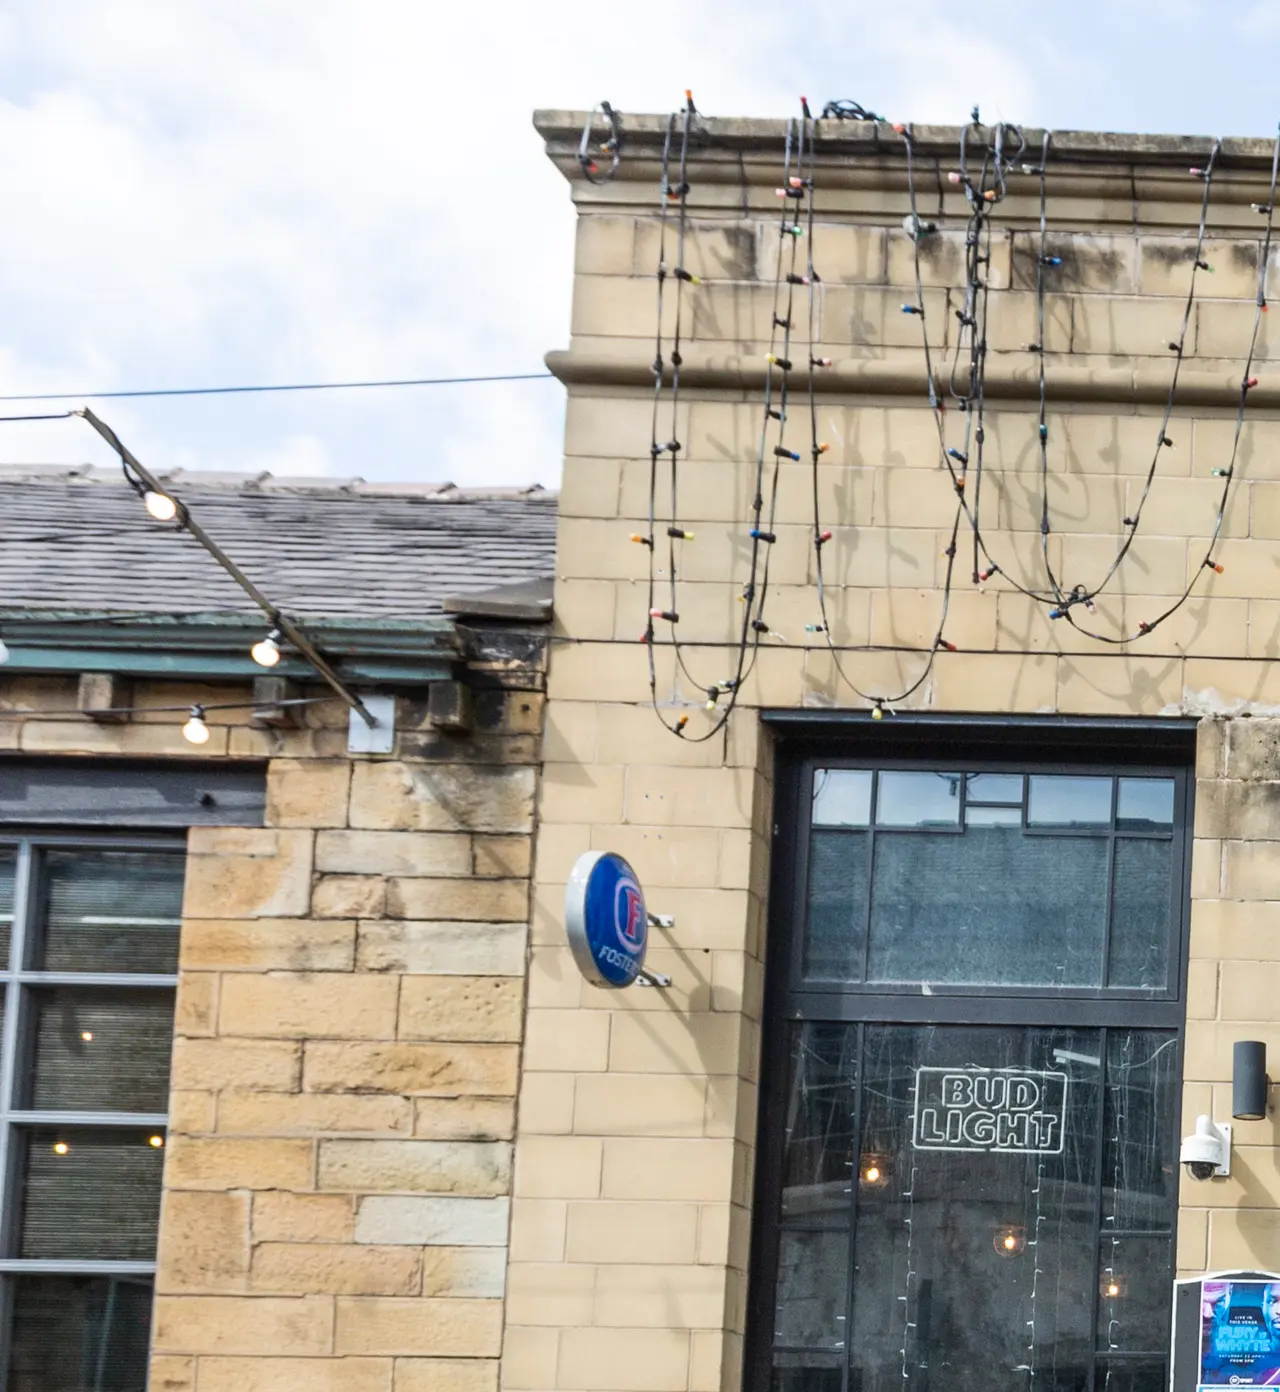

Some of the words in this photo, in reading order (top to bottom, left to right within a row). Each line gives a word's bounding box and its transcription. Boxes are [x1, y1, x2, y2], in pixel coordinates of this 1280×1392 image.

[942, 1075, 1039, 1110] BUD
[920, 1109, 1058, 1147] LIGHT
[1215, 1338, 1271, 1352] WHYTE
